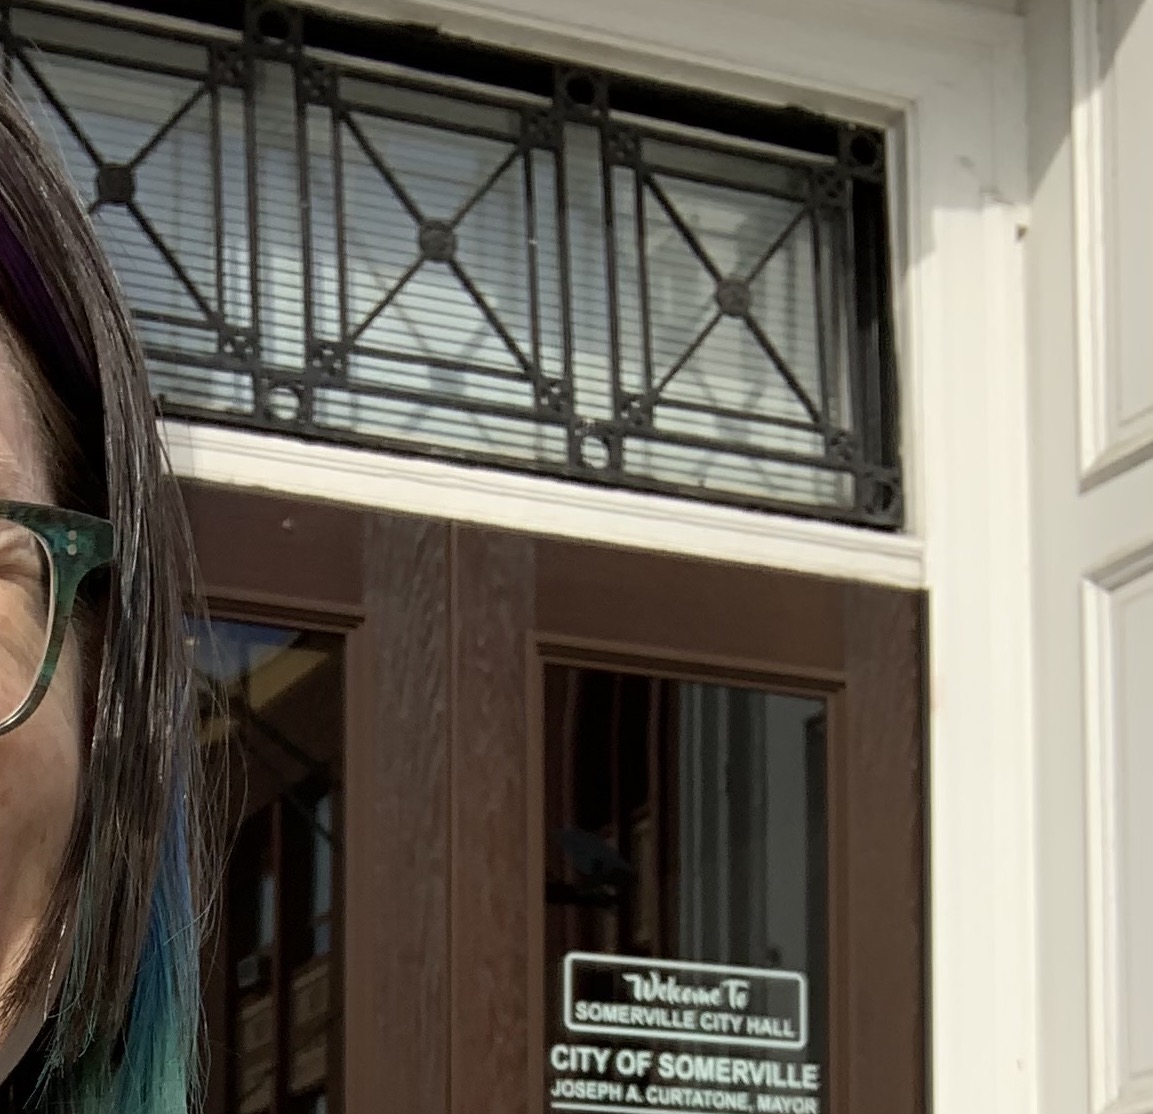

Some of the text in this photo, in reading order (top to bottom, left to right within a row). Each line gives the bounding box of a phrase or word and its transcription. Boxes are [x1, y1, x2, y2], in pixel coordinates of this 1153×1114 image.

[622, 970, 751, 1010] Welcome To
[575, 1000, 796, 1038] SOMERVILLE CITY HALL
[550, 1044, 821, 1091] CITY OF SOMERVILLE
[551, 1079, 622, 1101] JOSEPH
[624, 1084, 644, 1103] A.
